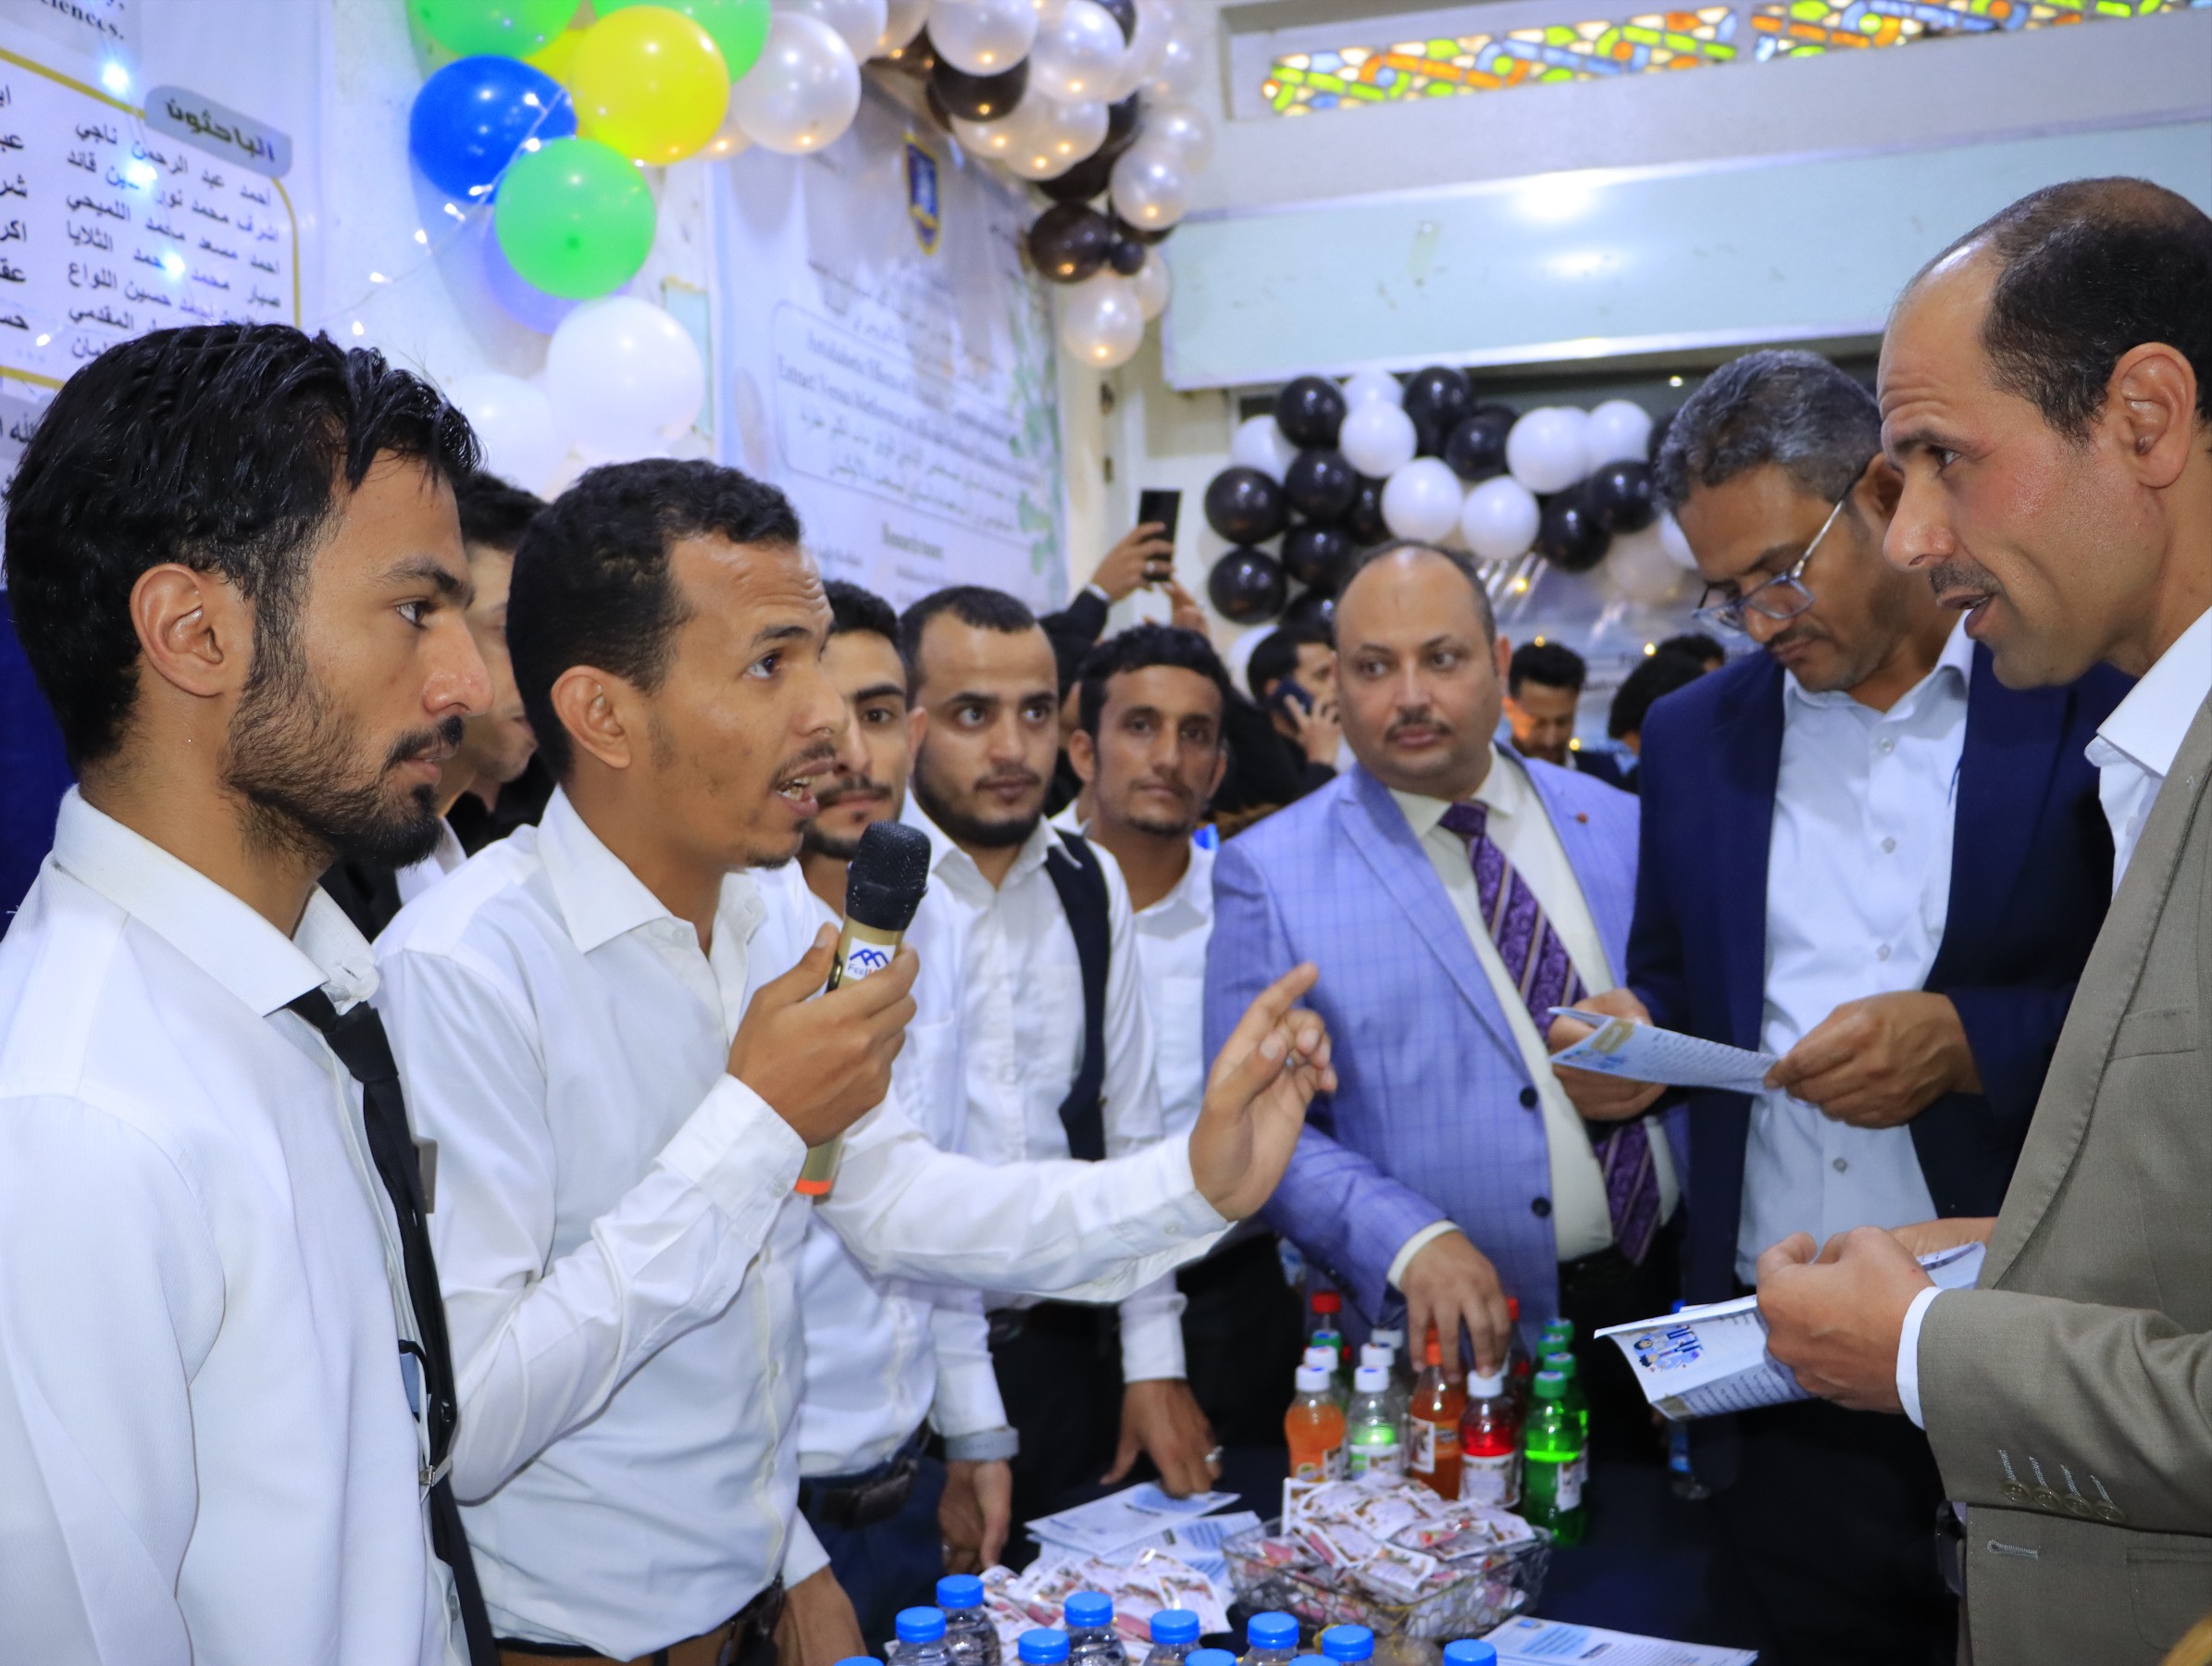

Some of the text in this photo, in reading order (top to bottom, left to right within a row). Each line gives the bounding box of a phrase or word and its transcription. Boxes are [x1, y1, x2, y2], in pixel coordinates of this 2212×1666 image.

[41, 0, 124, 40] iences.
[76, 124, 118, 144] ناجي
[166, 97, 276, 163] الباحثون
[202, 169, 225, 190] عبد
[192, 199, 230, 223] محمد
[146, 217, 185, 241] محمد
[133, 248, 168, 270] حمد
[192, 268, 230, 291] محمد
[125, 280, 171, 306] حسين
